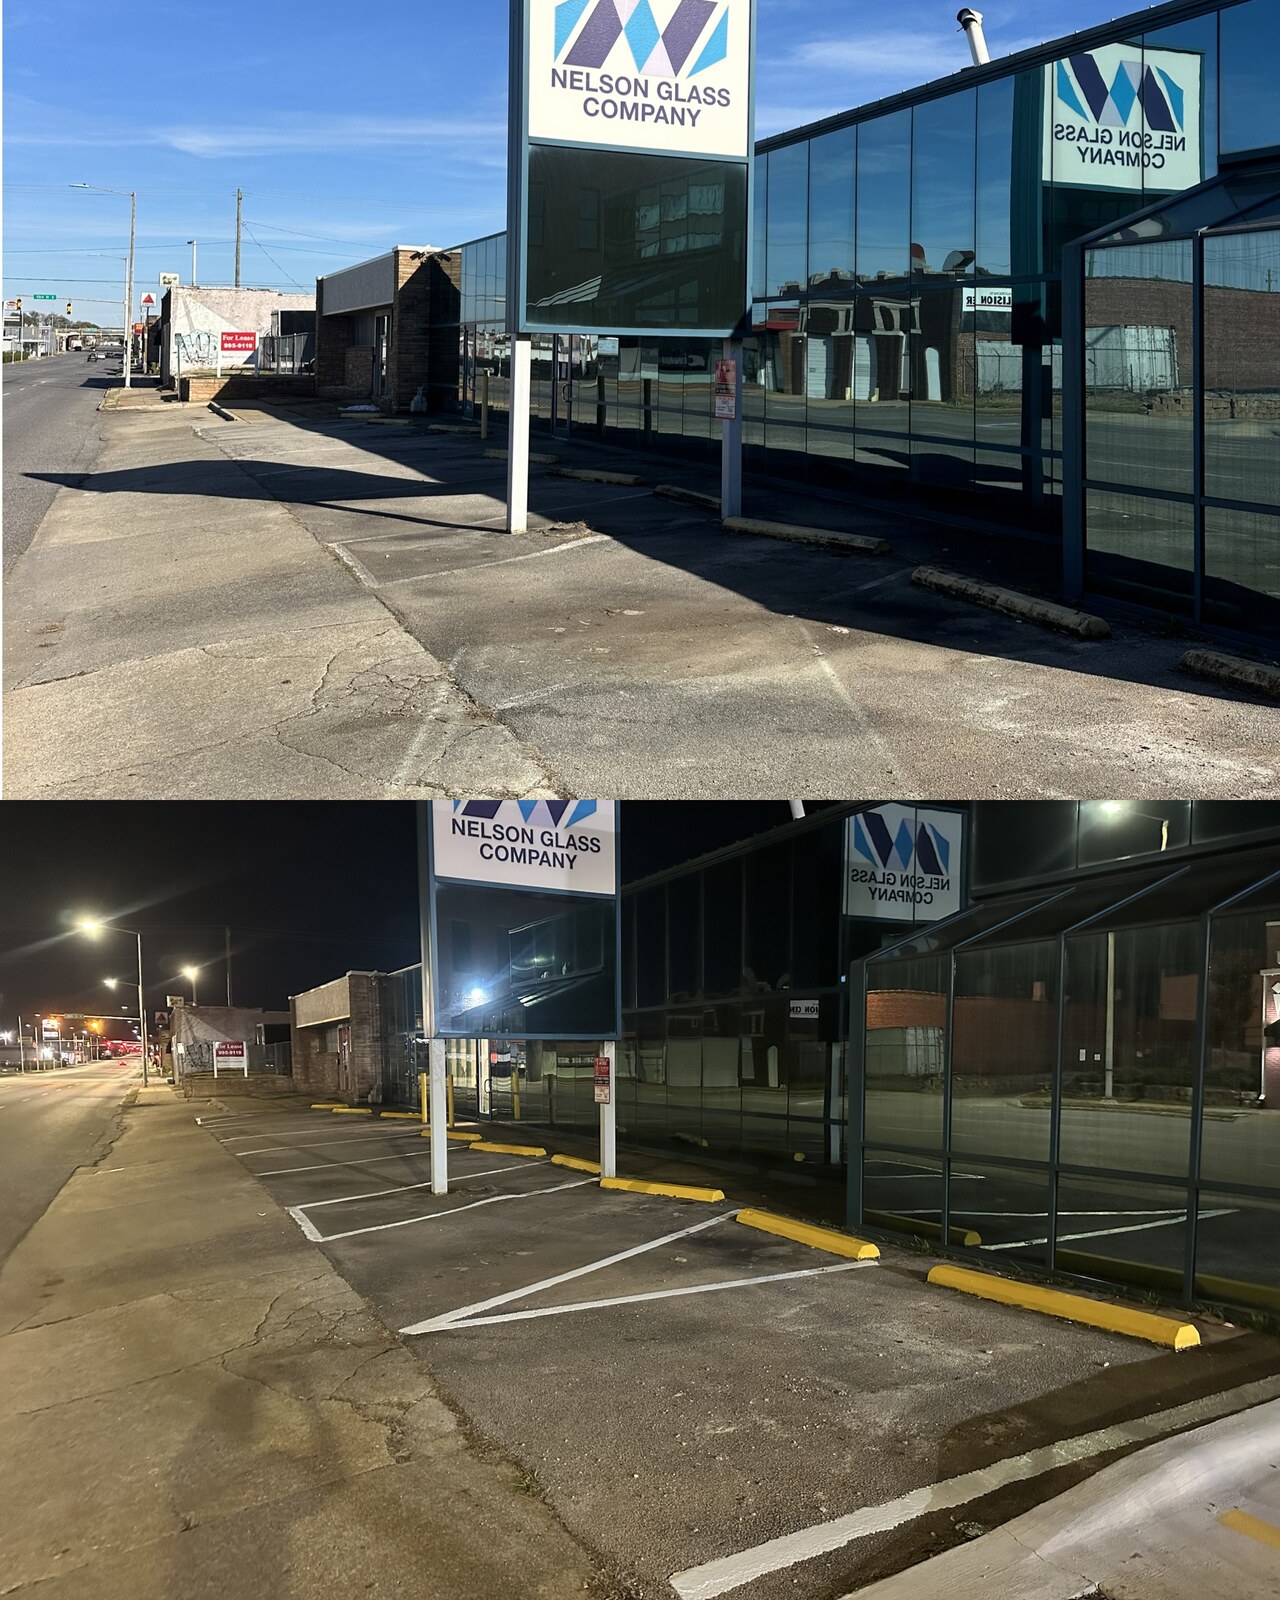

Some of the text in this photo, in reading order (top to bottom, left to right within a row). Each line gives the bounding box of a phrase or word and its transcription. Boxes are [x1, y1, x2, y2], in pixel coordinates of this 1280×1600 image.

[551, 68, 731, 107] NELSON GLASS
[583, 97, 701, 127] COMPANY
[451, 818, 601, 853] NELSON GLASS
[480, 843, 577, 870] COMPANY
